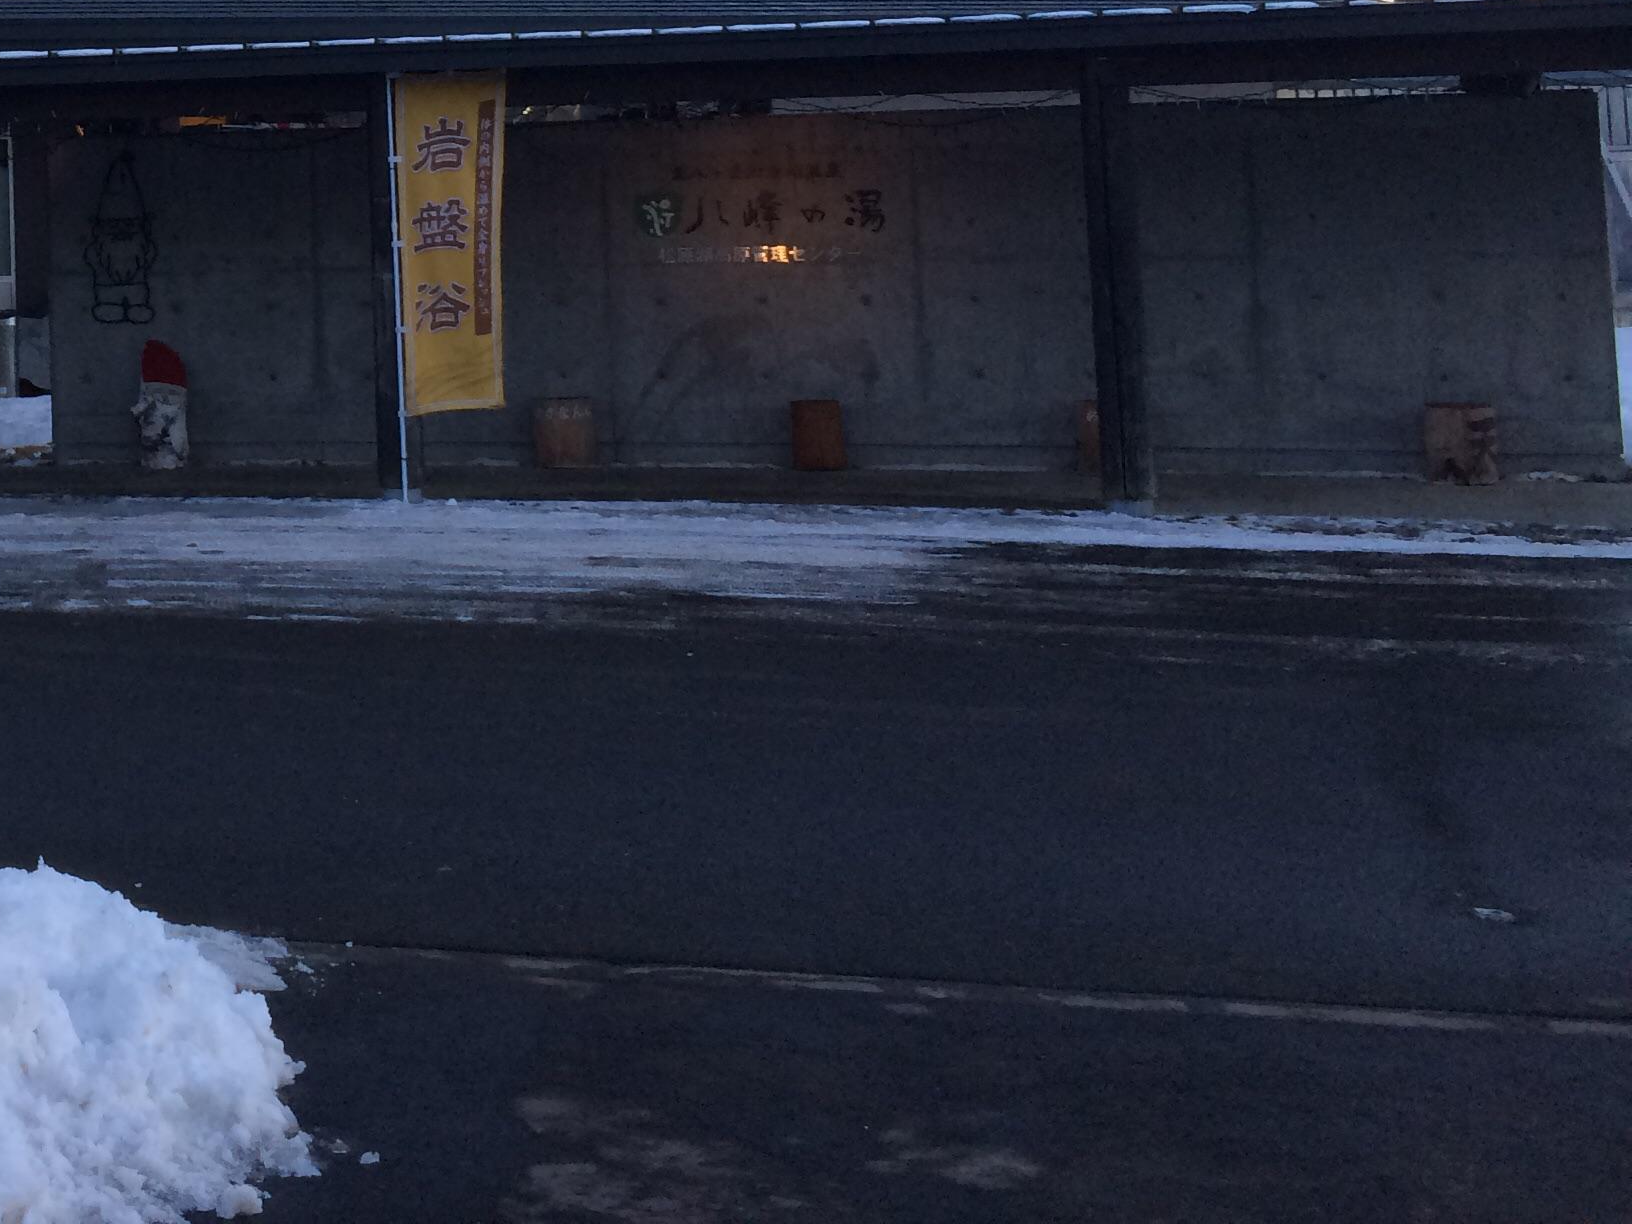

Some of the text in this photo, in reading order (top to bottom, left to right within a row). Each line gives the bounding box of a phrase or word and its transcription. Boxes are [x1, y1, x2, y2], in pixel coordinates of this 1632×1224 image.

[411, 116, 471, 332] 岩盤浴
[685, 189, 886, 234] 八峰の湯
